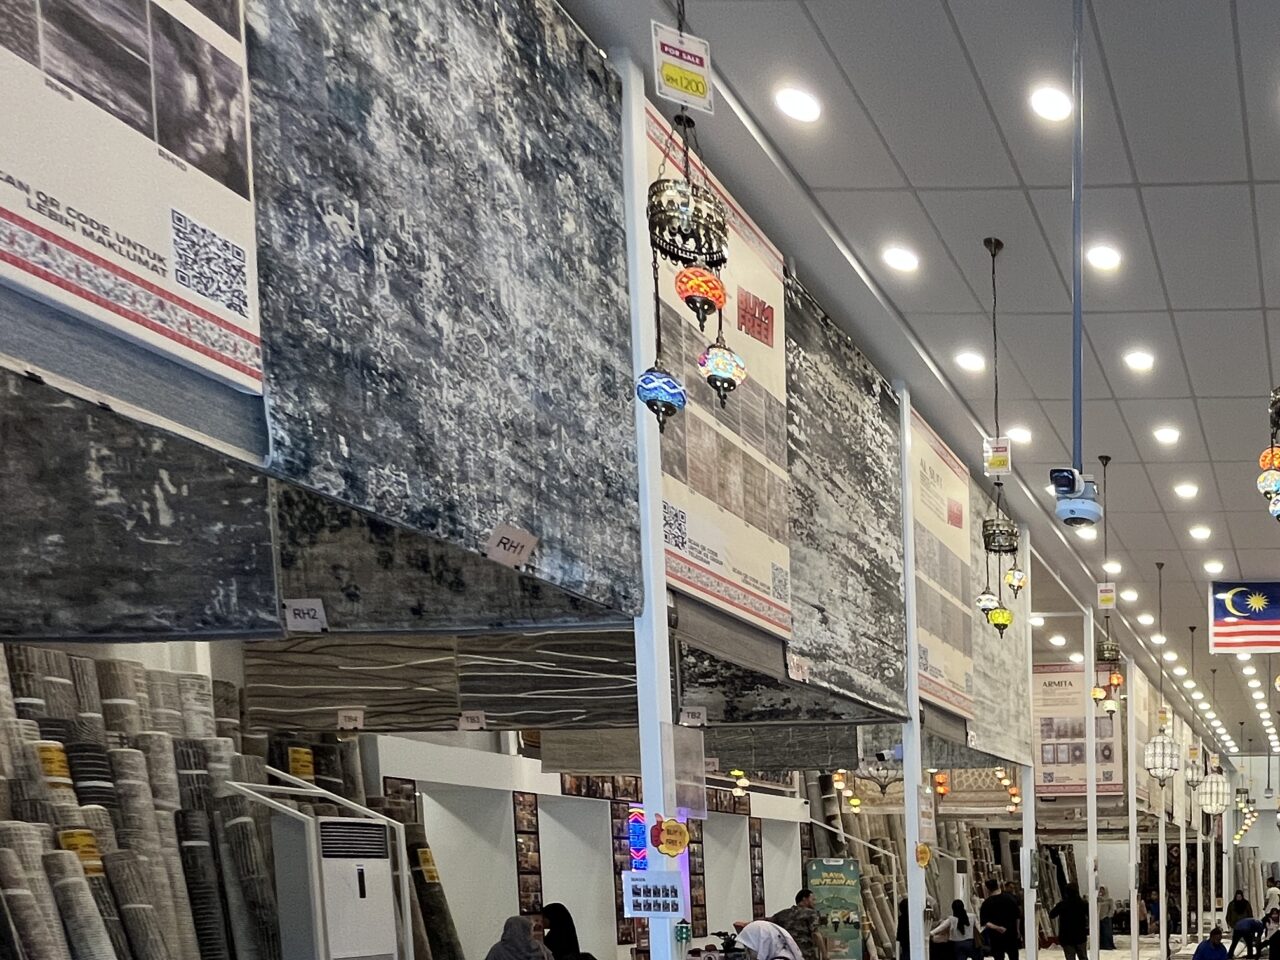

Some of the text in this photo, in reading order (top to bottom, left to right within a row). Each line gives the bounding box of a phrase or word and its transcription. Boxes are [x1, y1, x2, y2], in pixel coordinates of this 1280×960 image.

[664, 45, 701, 65] FOR SALE
[27, 198, 168, 278] LEBIH MAKLUMAT
[36, 190, 61, 211] QR
[66, 206, 110, 237] CODE
[115, 232, 168, 268] UNTUK
[496, 536, 525, 555] RH1
[293, 608, 319, 620] RH2
[1042, 680, 1073, 688] ARMITA
[686, 711, 702, 719] TB2
